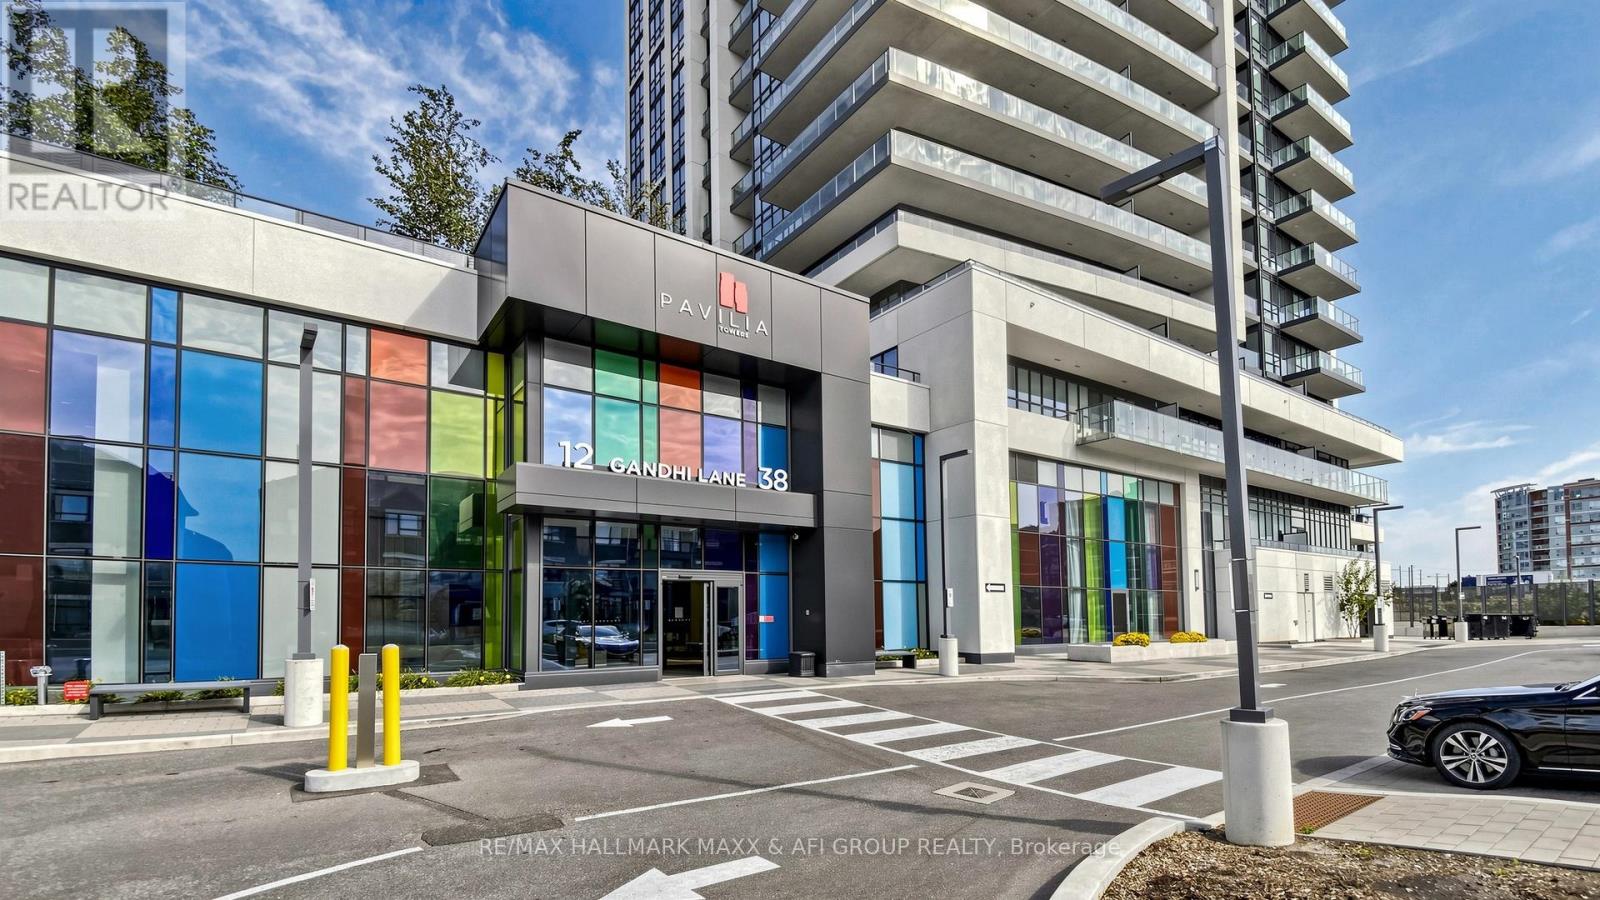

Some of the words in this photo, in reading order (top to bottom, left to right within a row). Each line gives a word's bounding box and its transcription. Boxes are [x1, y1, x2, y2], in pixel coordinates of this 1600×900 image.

[660, 291, 768, 336] PAVILIA
[558, 440, 594, 470] 12
[609, 457, 691, 482] GANDHI
[698, 468, 747, 488] LANE
[758, 467, 789, 492] 38
